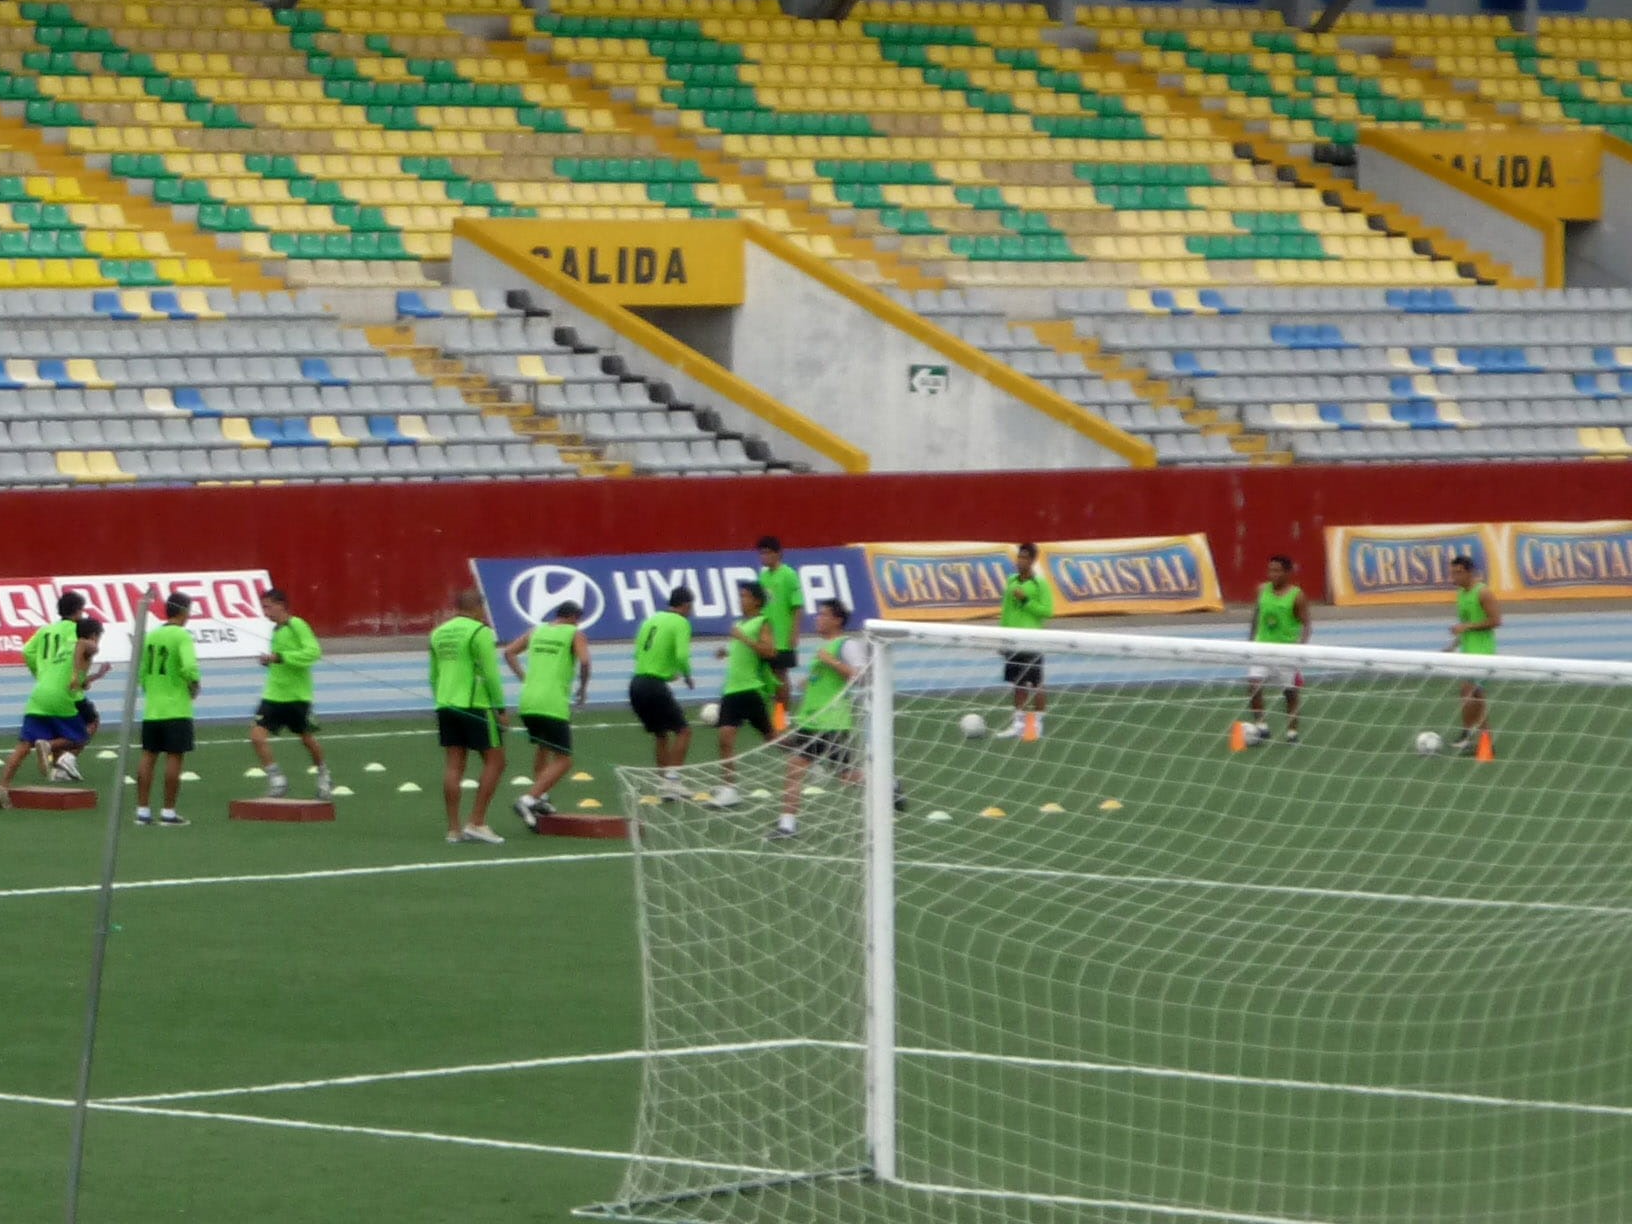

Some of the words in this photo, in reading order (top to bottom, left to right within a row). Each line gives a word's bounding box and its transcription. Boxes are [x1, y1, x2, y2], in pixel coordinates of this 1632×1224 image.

[1431, 154, 1555, 187] LIDA
[613, 563, 855, 621] HYUNAI
[1058, 555, 1199, 597] CRISTAL
